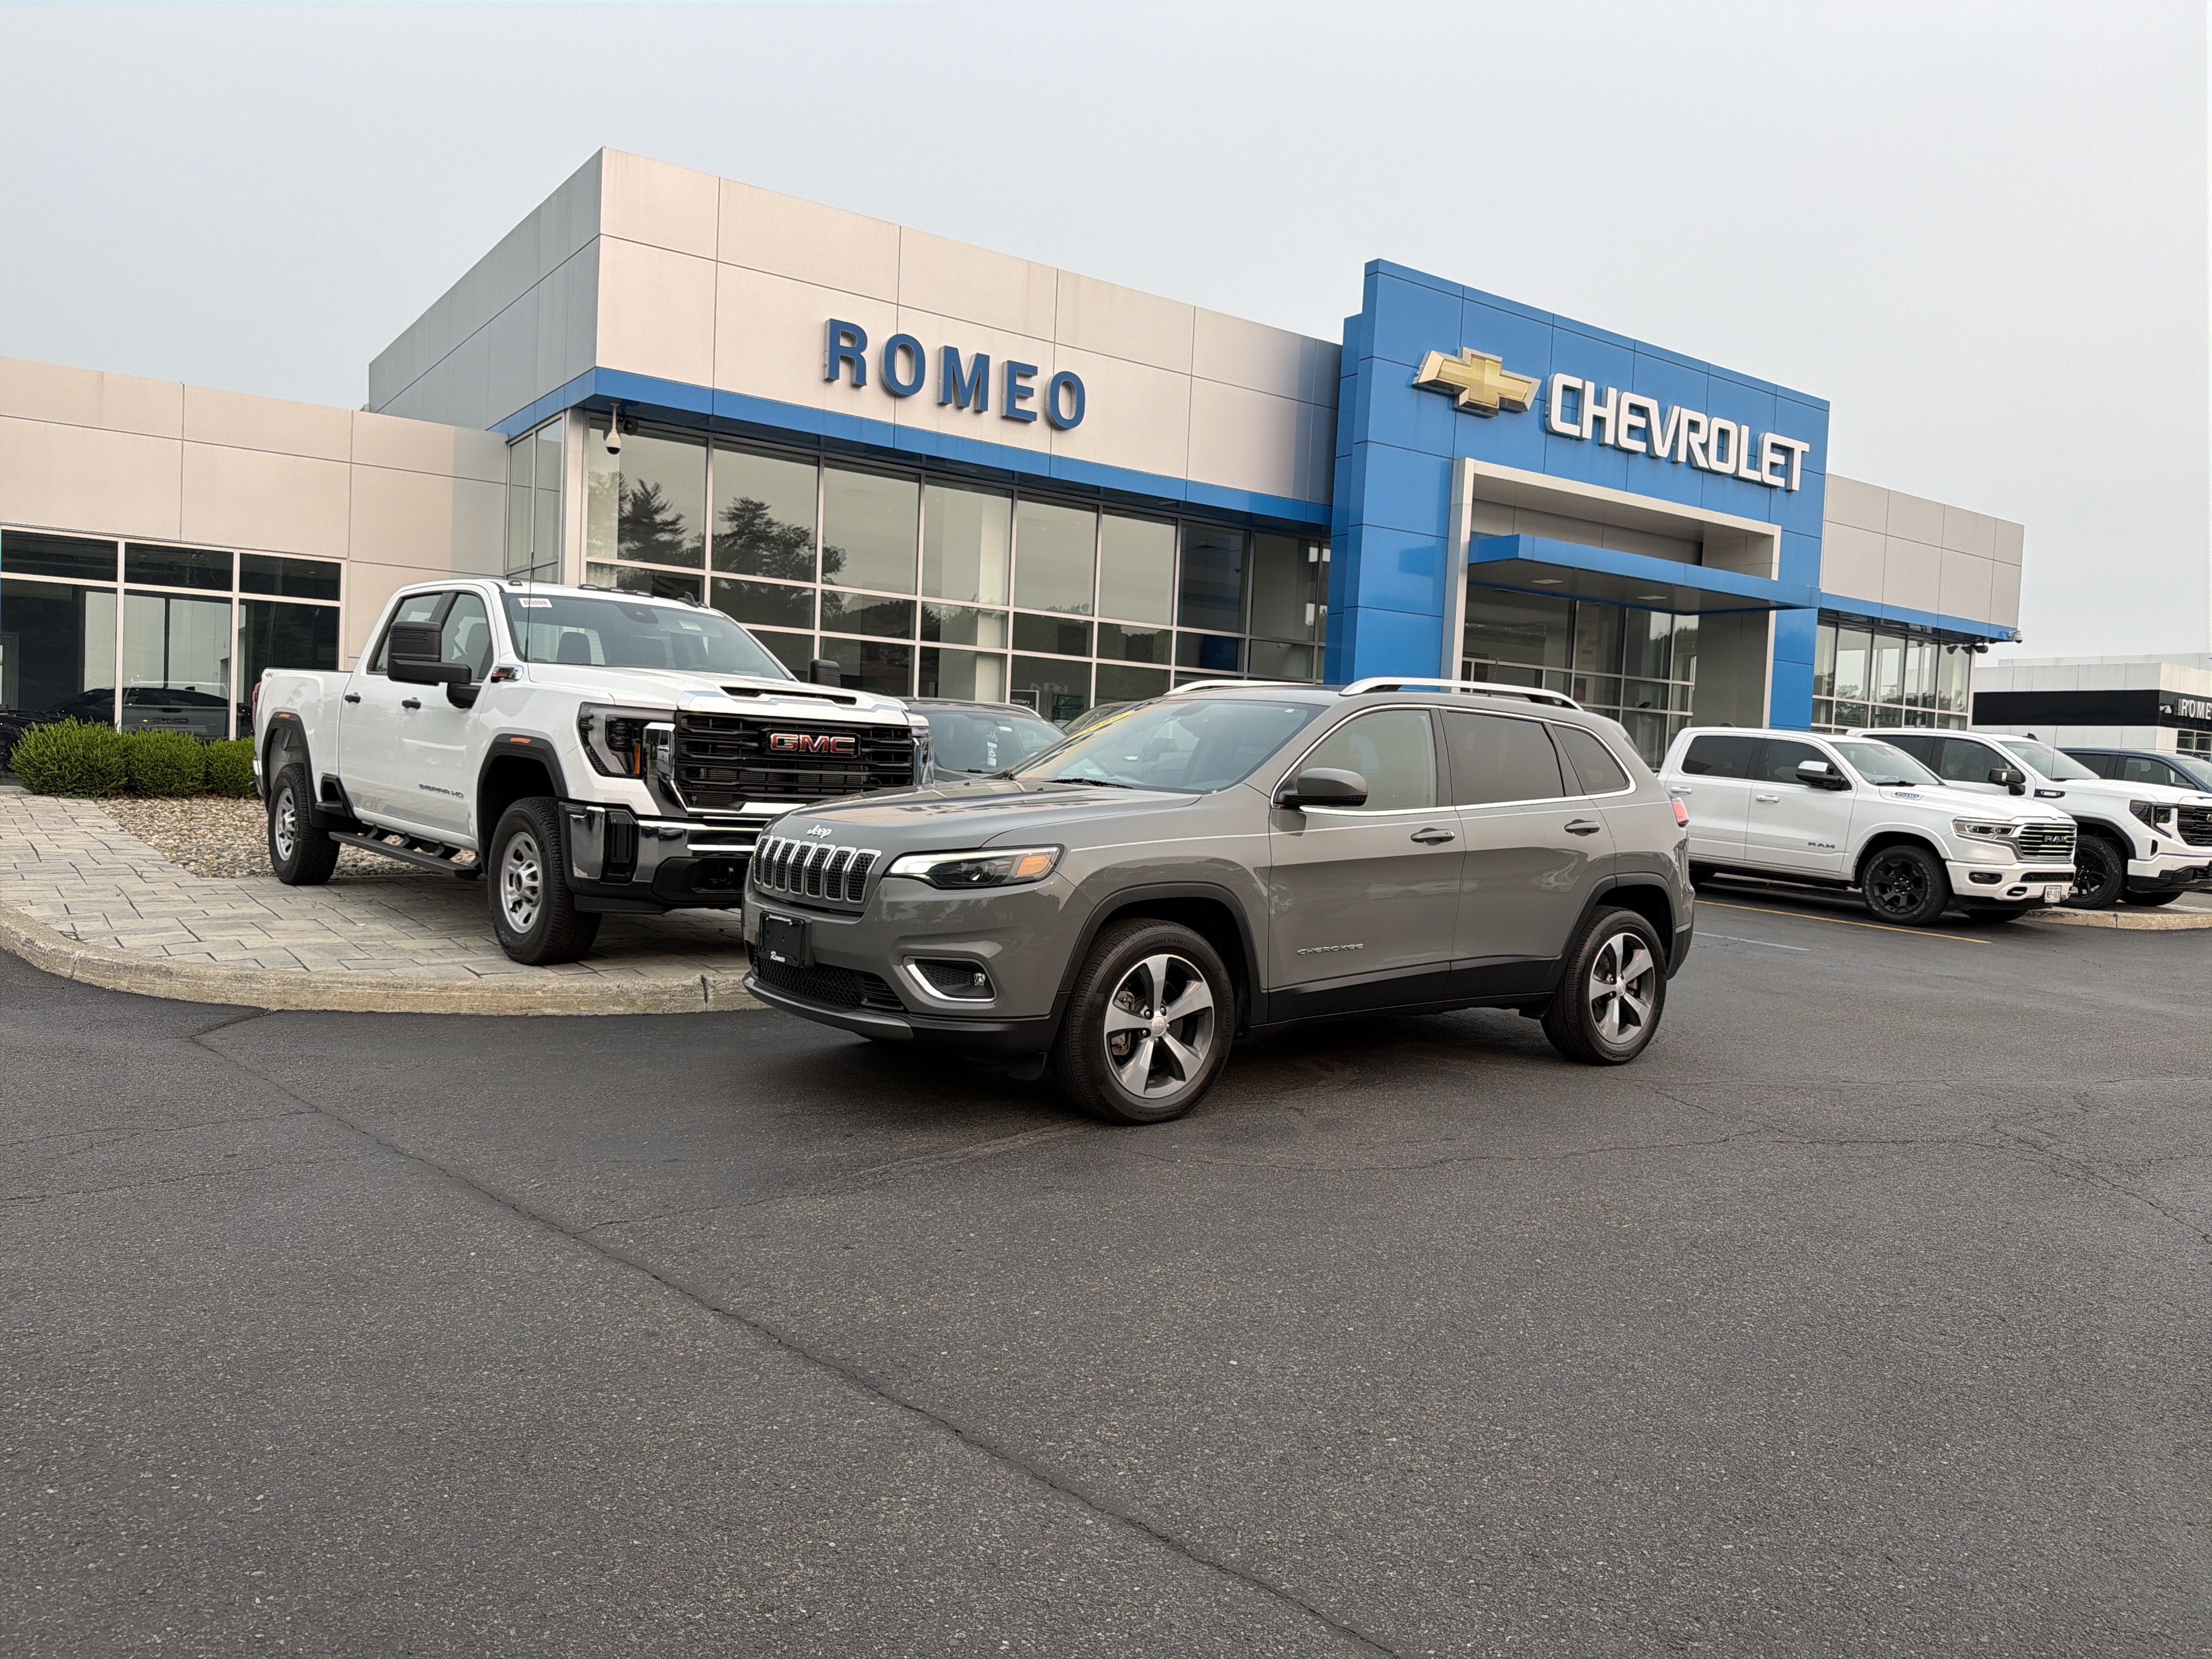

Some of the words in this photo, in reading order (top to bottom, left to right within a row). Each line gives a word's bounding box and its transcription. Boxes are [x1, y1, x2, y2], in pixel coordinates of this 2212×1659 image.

[824, 318, 1085, 430] ROMEO
[1544, 373, 1810, 492] CHEVROLET
[770, 733, 855, 756] GMC
[451, 790, 464, 799] HD
[806, 824, 832, 839] Jeep
[1297, 944, 1363, 955] CHEROKEE
